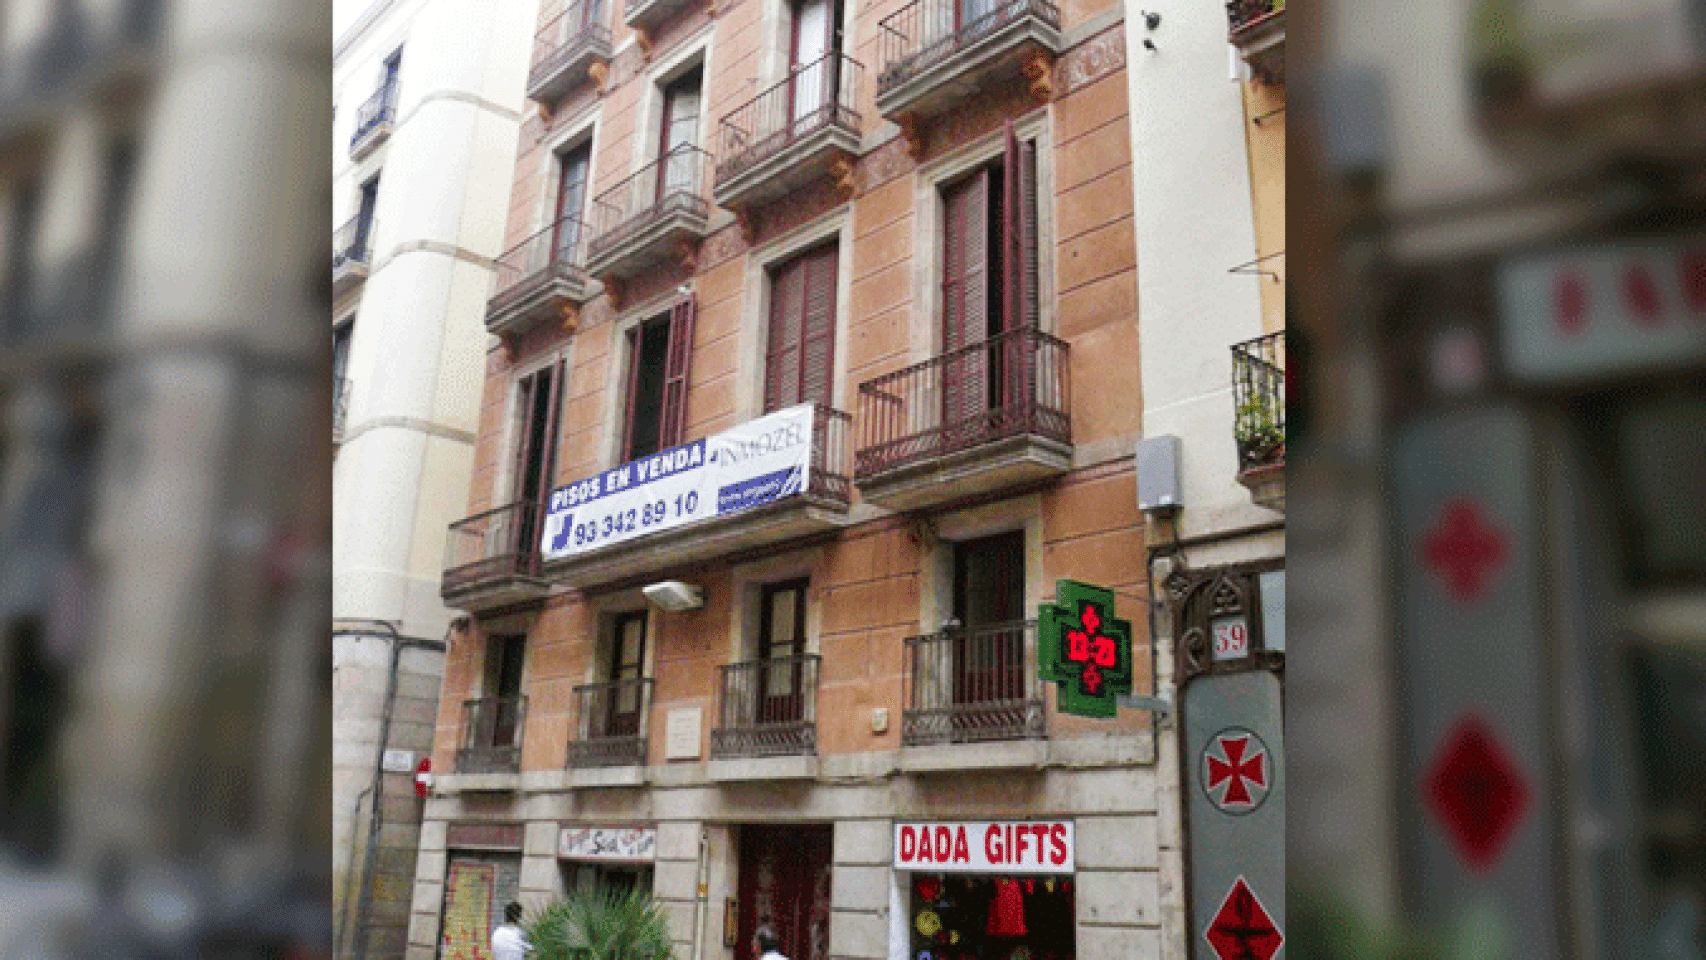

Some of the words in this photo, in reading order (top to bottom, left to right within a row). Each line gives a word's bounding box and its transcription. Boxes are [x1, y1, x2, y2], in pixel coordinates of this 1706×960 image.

[552, 479, 600, 511] PISOS
[607, 465, 630, 492] EN
[637, 444, 702, 480] VENDA
[576, 521, 597, 545] 93
[602, 509, 635, 537] 342
[675, 491, 698, 517] 10
[900, 826, 971, 863] DADA
[984, 823, 1068, 867] GIFTS
